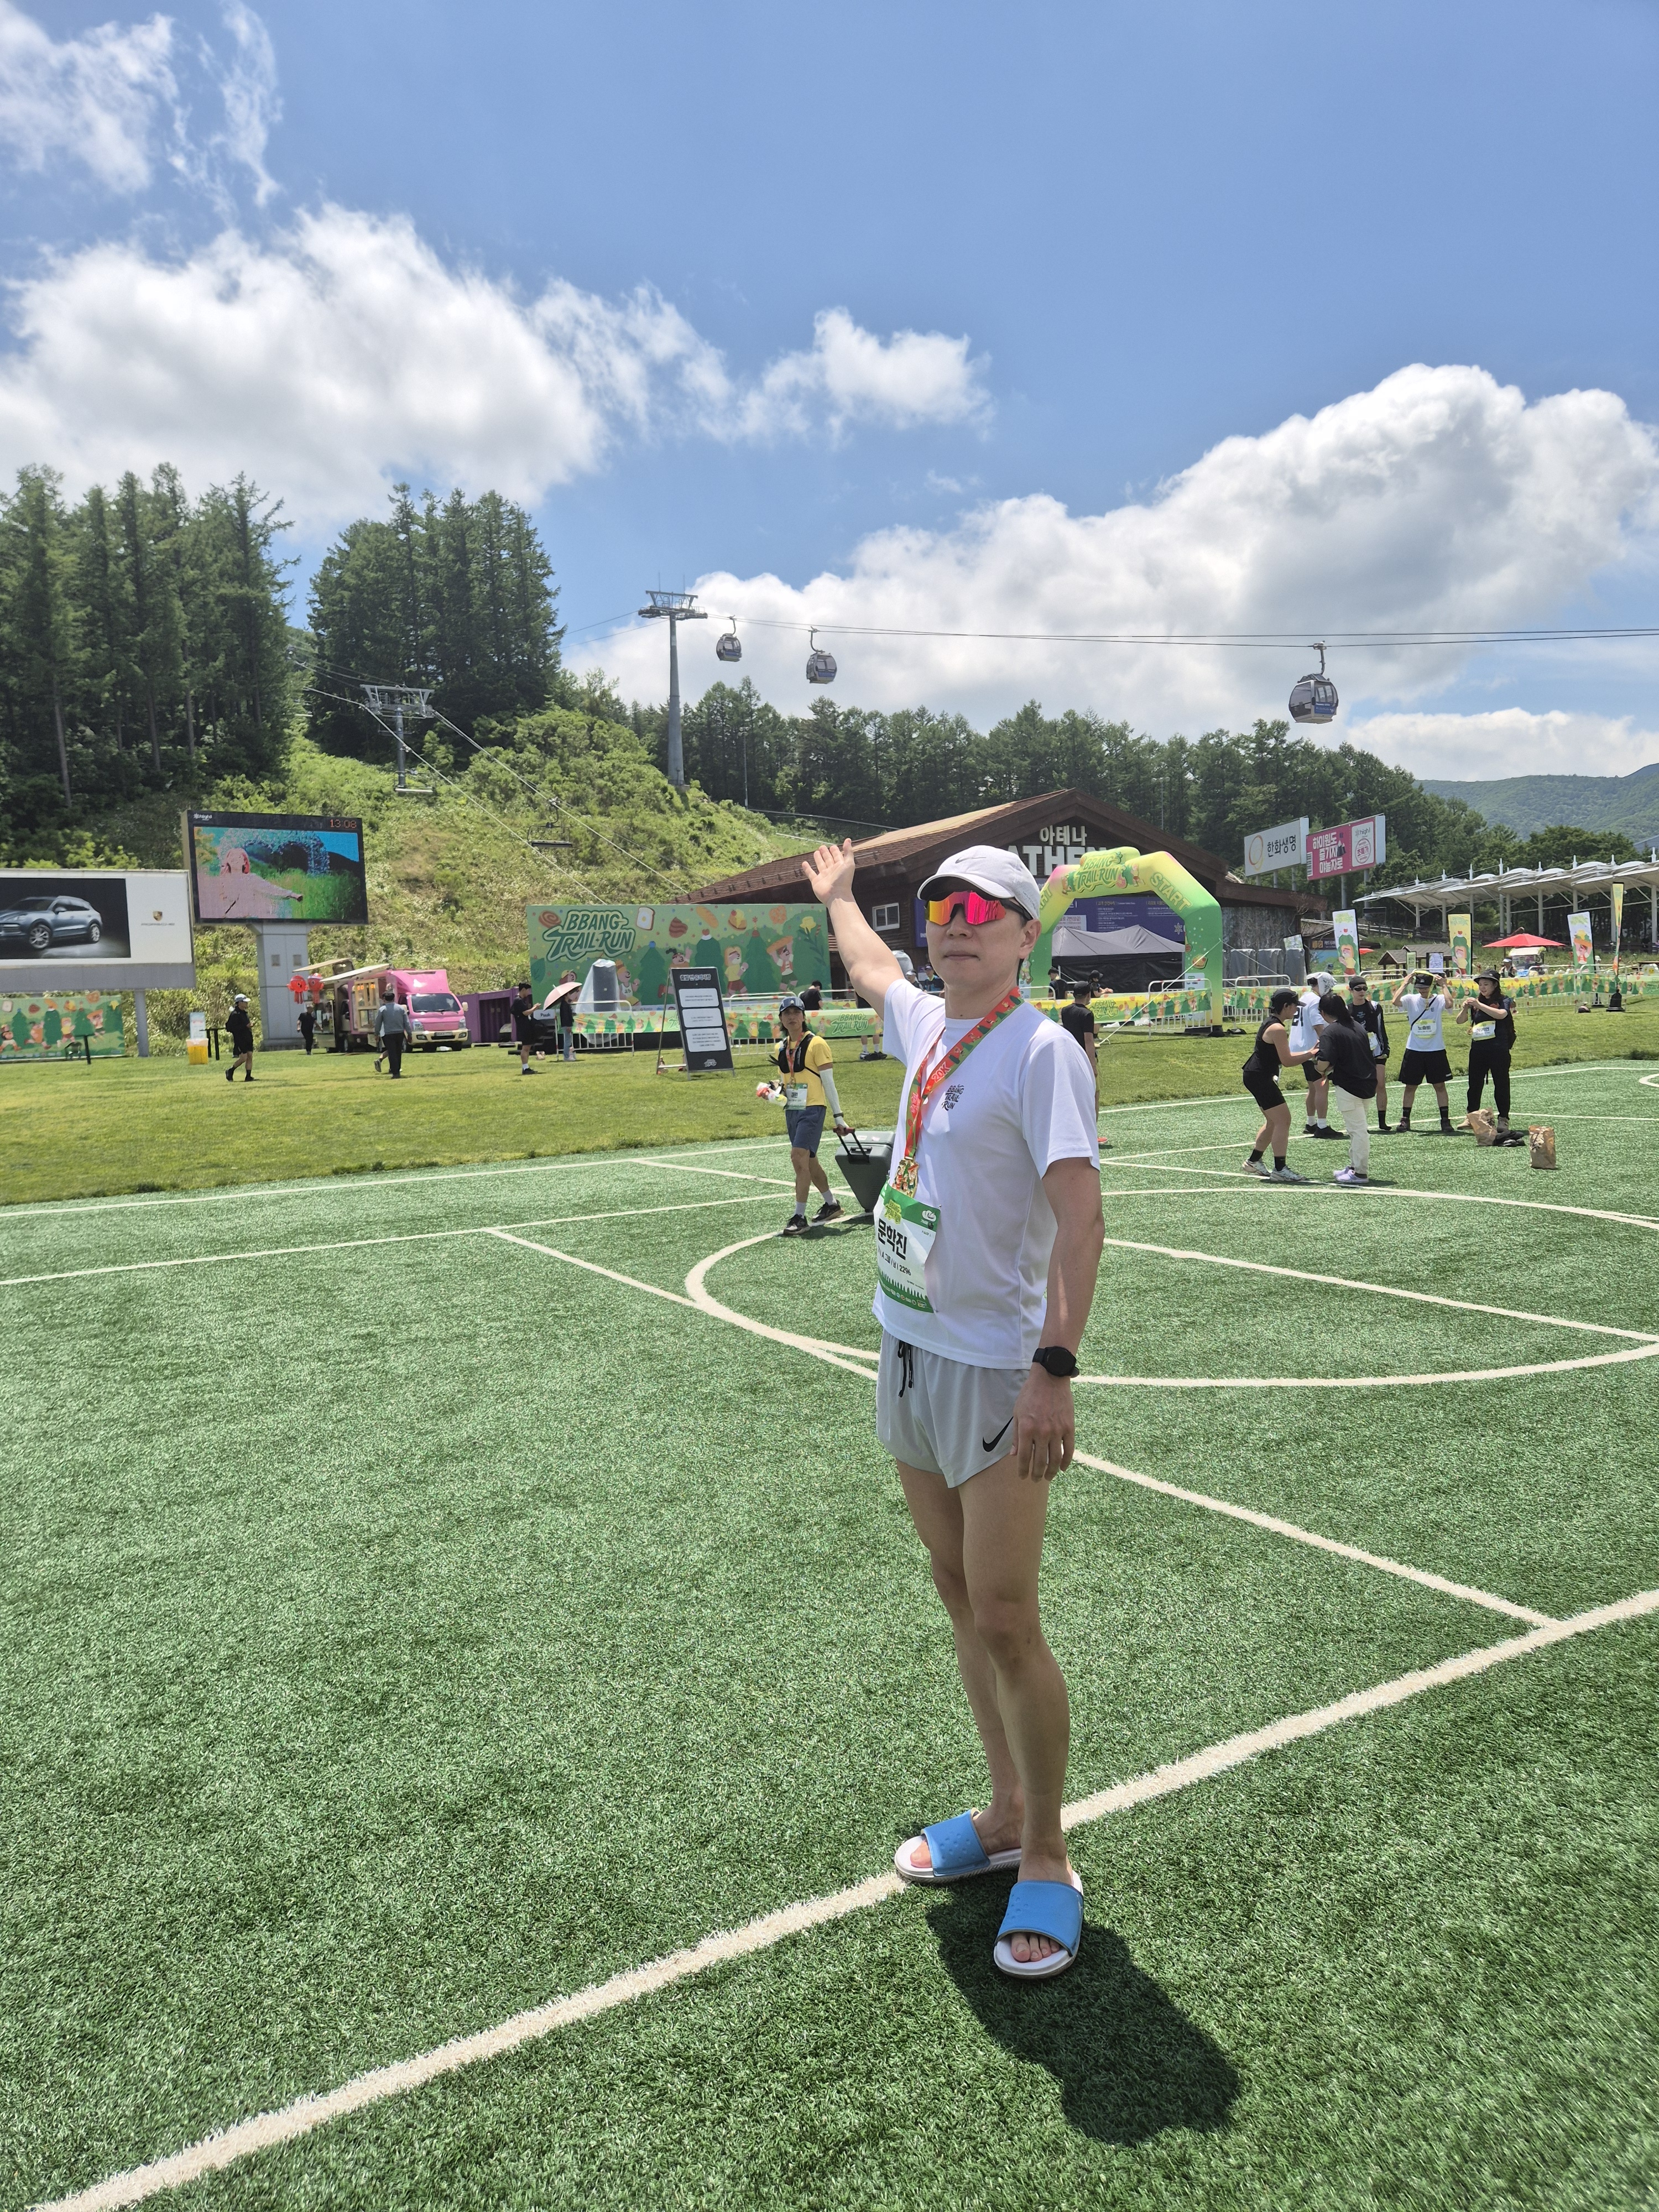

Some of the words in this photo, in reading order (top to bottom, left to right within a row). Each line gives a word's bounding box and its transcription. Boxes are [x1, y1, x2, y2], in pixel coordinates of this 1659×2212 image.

[1039, 825, 1087, 846] 아테나
[1313, 832, 1337, 849] 하이원도
[1267, 834, 1296, 858] 한화생명
[1319, 844, 1338, 861] 즐기자
[1083, 856, 1115, 870] BBANG
[1151, 873, 1191, 911] START
[566, 914, 624, 931] BBANG
[839, 1013, 864, 1021] BBANG
[1292, 1007, 1304, 1027] 21
[931, 1061, 952, 1083] 20K
[947, 1084, 964, 1095] BBANG
[941, 1100, 956, 1112] RUN
[878, 1218, 907, 1260] 문학진
[899, 1264, 911, 1276] 2296
